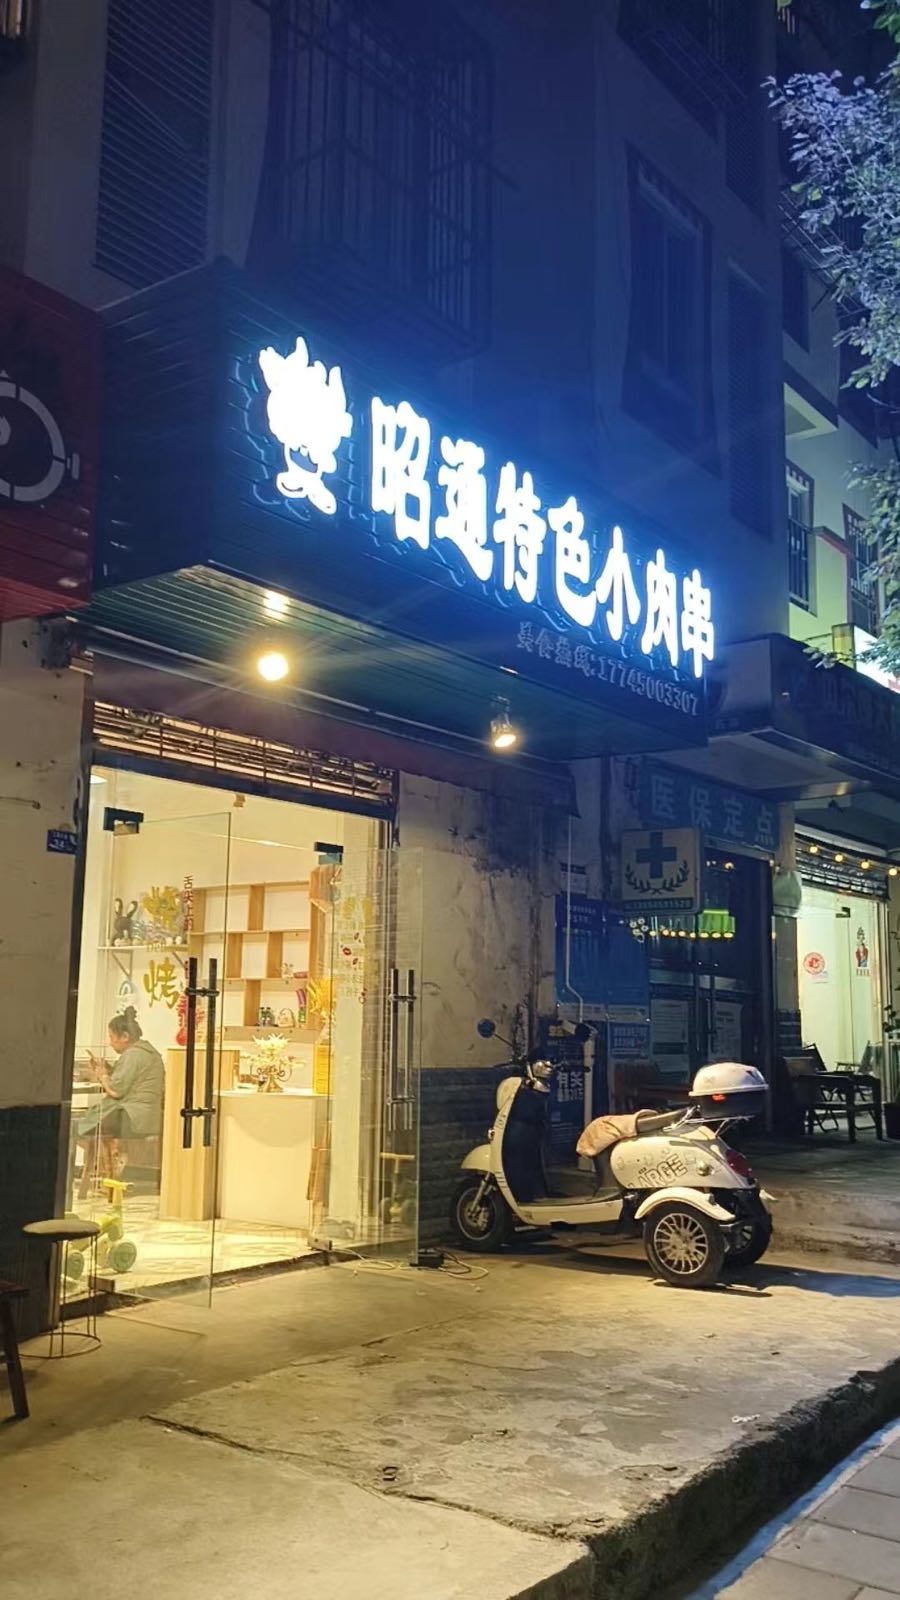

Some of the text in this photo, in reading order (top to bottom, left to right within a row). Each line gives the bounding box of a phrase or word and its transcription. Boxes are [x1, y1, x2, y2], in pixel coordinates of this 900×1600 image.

[371, 396, 715, 678] 昭通特色小肉串
[650, 774, 775, 846] 医保定点
[626, 1152, 689, 1188] ARGE
